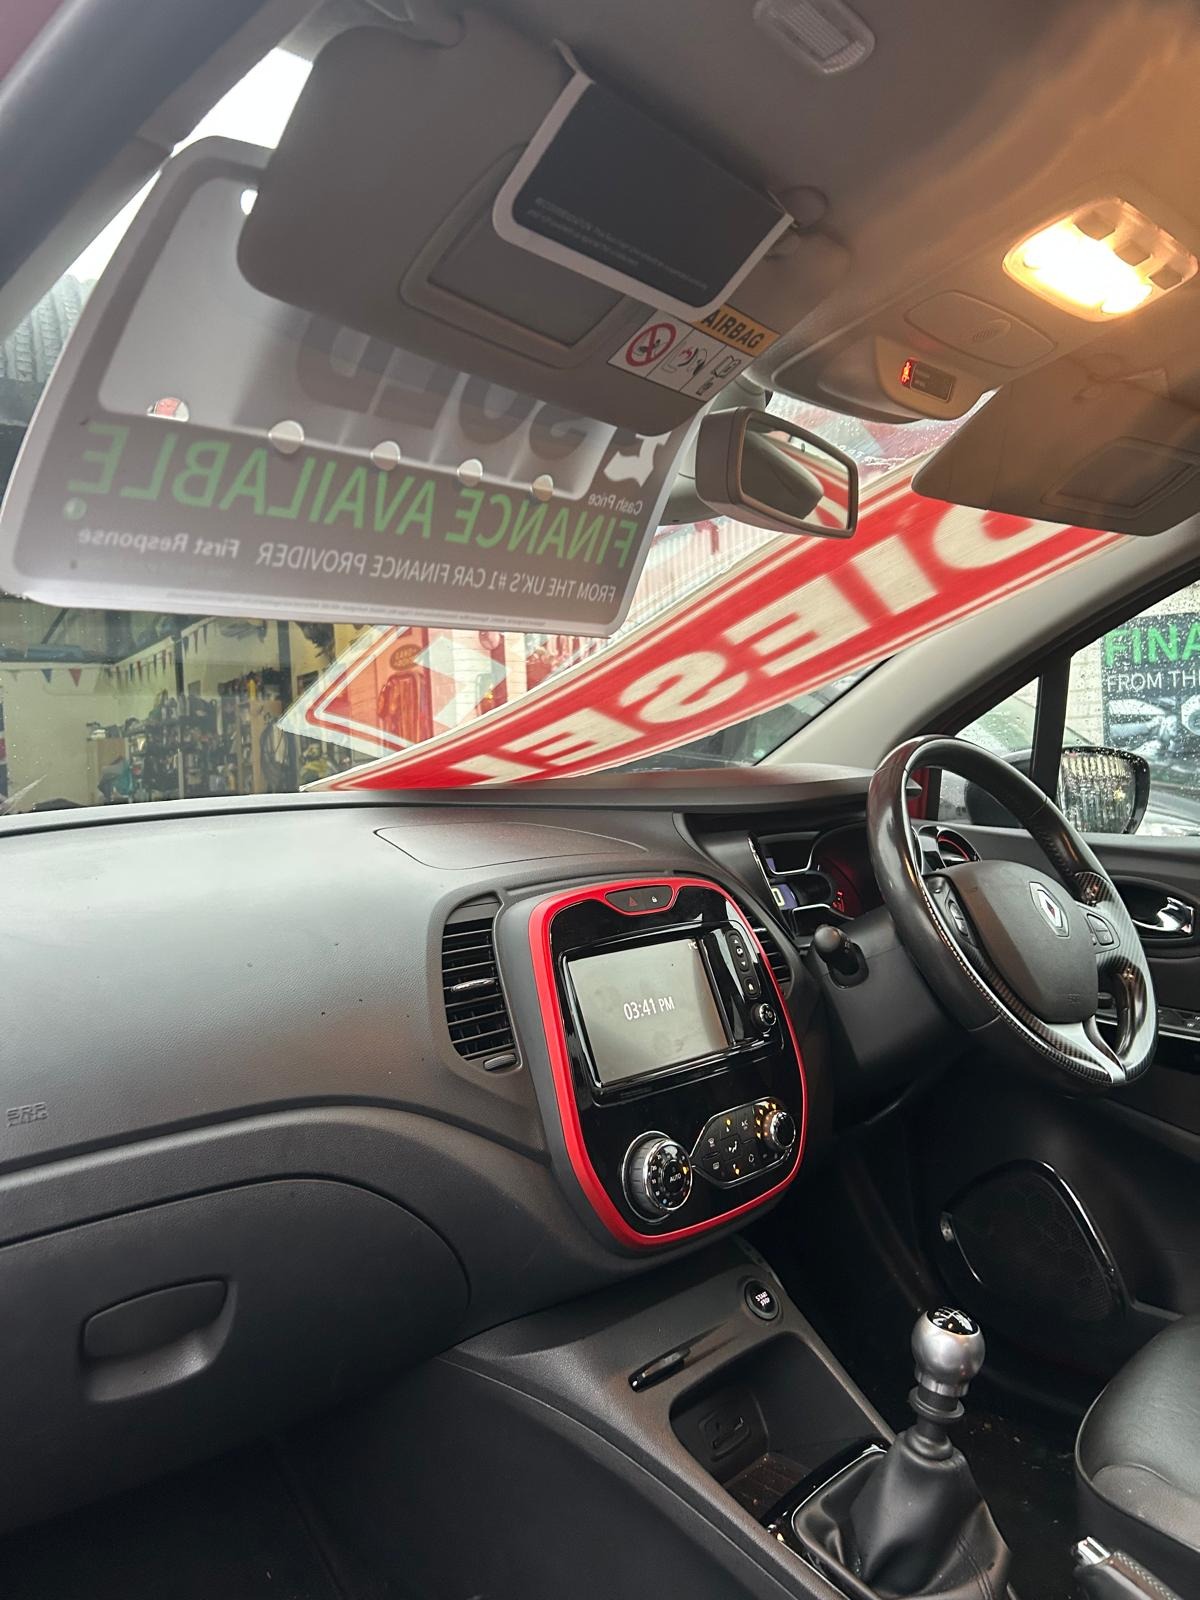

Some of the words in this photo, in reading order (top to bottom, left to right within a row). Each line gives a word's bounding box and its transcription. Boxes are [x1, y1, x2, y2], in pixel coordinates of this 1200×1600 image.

[701, 308, 765, 348] AIRBAG
[1107, 672, 1163, 693] FROM
[1168, 669, 1200, 689] TH
[623, 997, 657, 1021] 03:41
[658, 996, 675, 1013] PM
